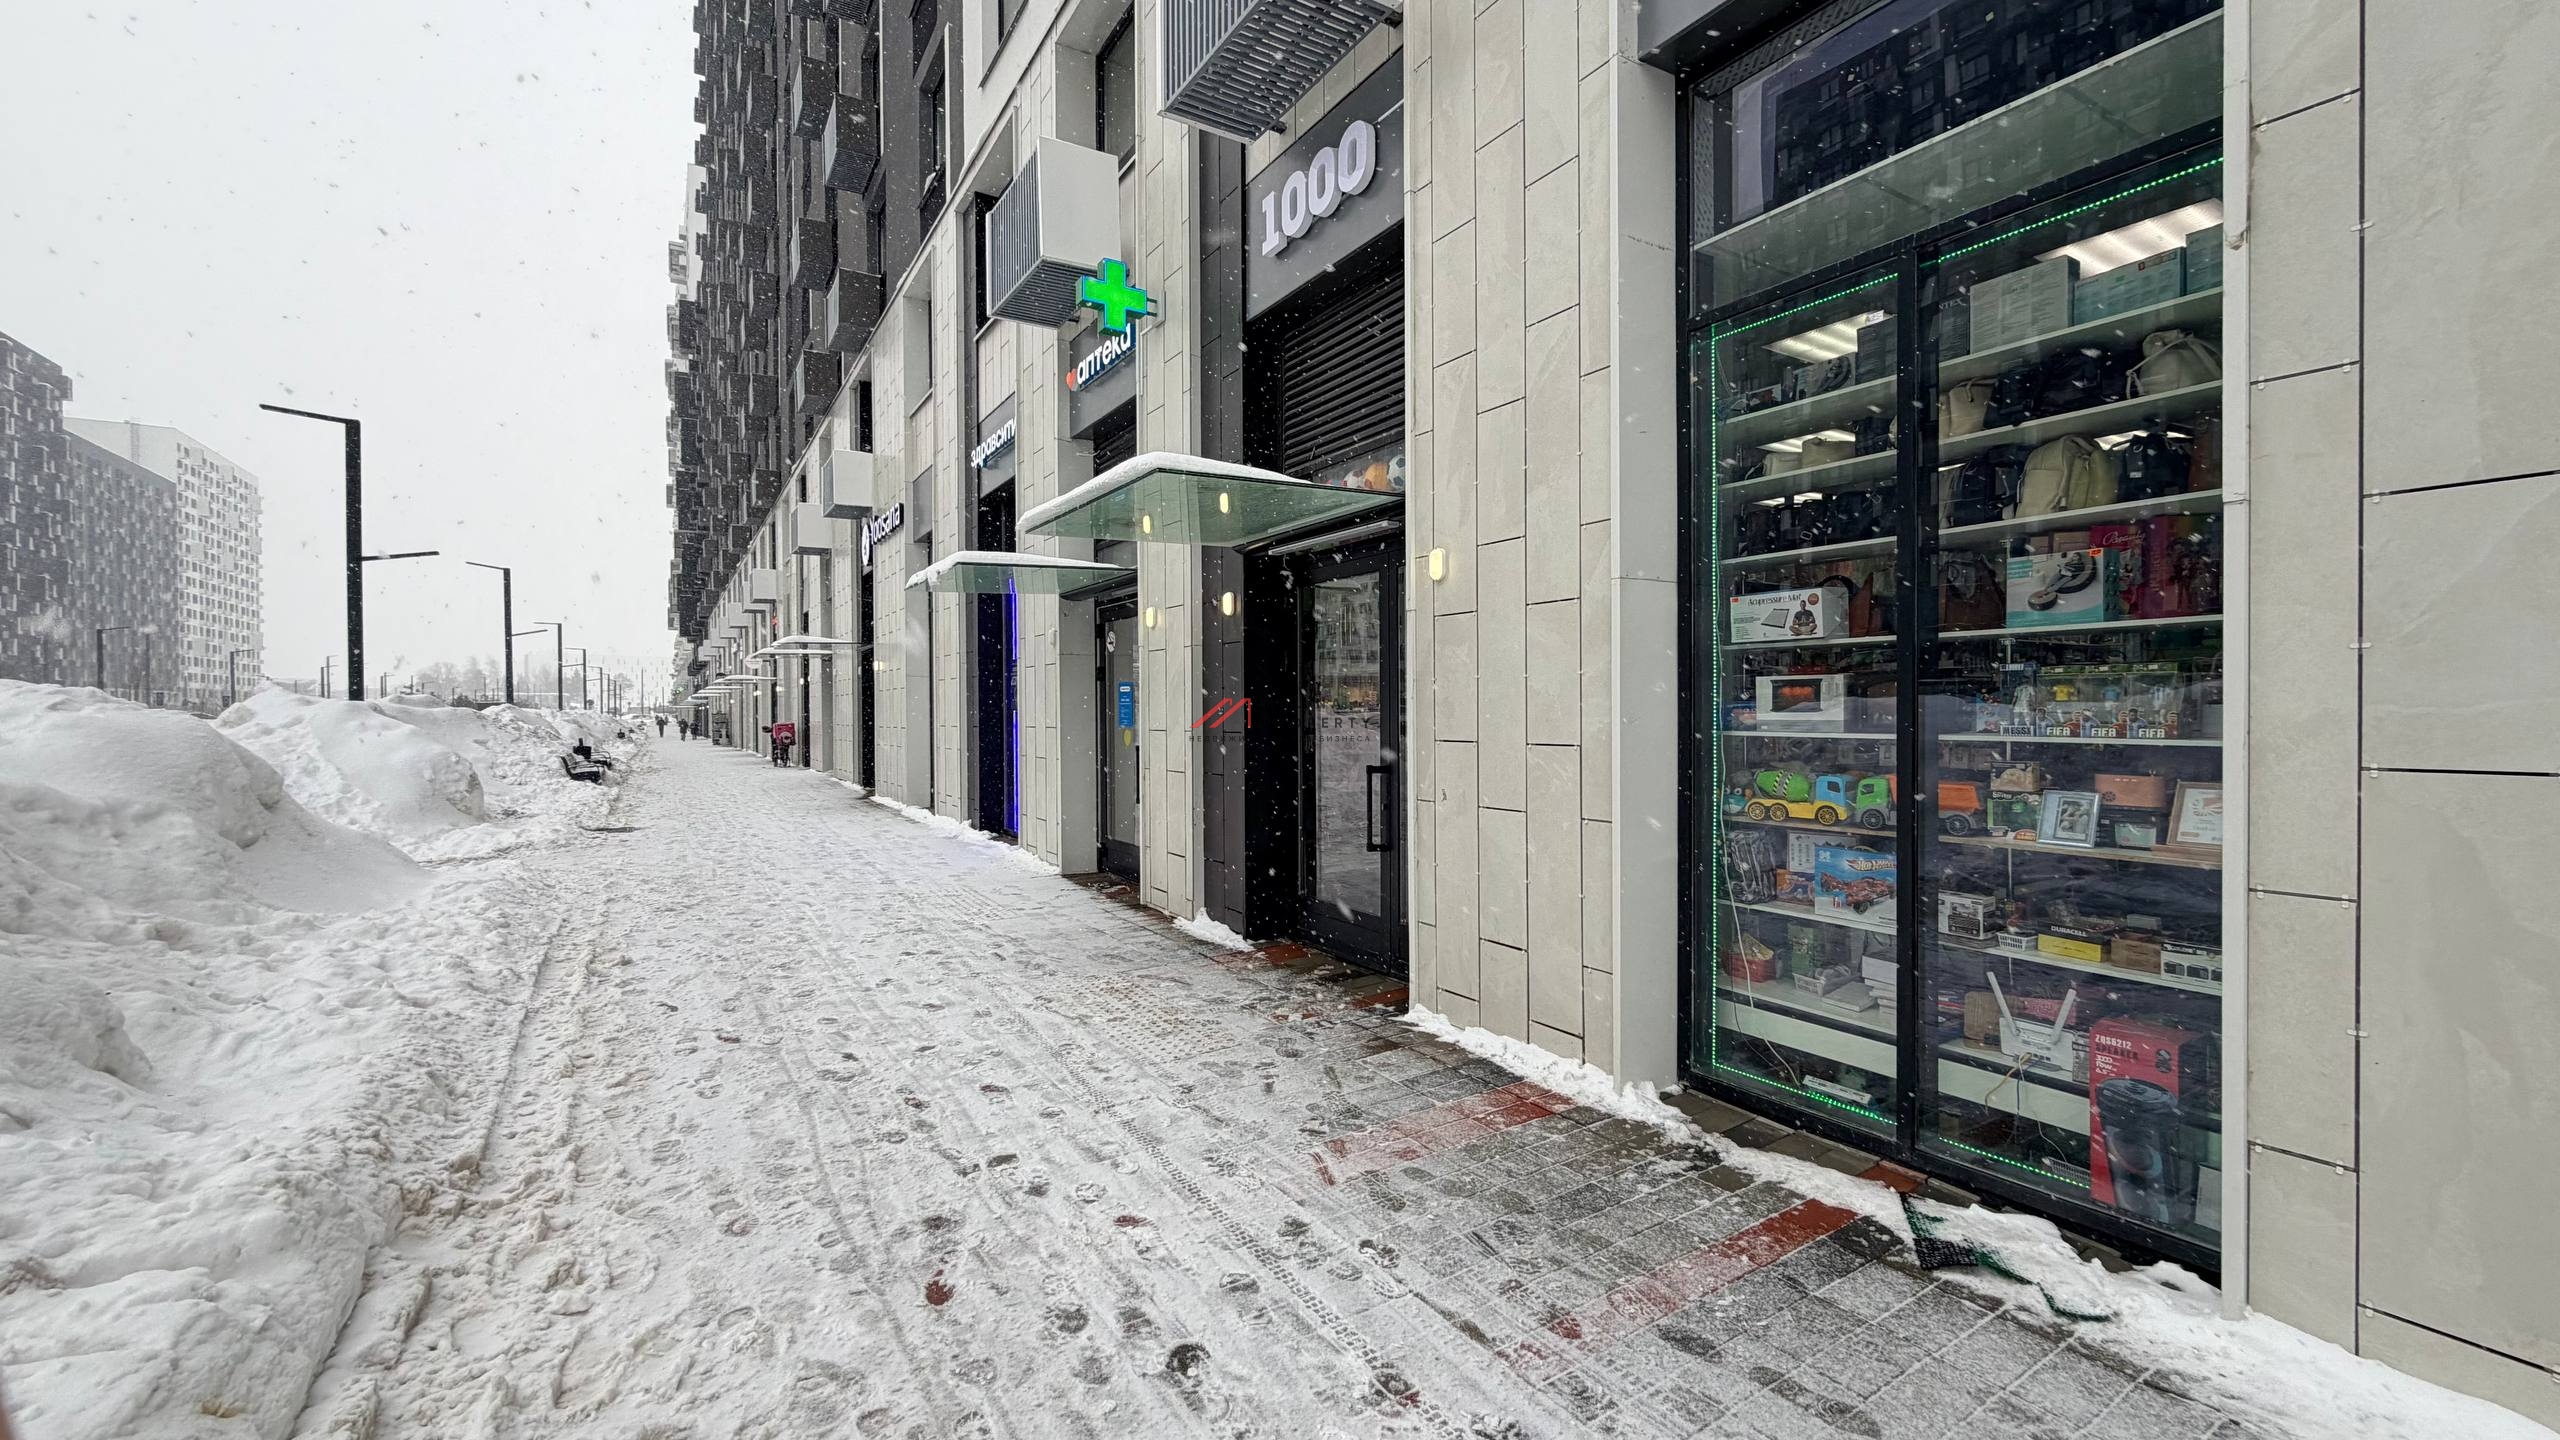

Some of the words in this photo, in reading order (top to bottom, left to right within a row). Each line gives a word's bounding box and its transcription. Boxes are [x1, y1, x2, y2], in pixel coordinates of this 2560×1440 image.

[1262, 120, 1376, 257] 1000
[1077, 323, 1131, 384] аптека
[869, 502, 900, 545] Yoosana
[2046, 727, 2071, 737] FIFA
[2091, 727, 2116, 737] FIFA
[2138, 728, 2165, 738] FIFA
[2051, 925, 2088, 937] DURACELL
